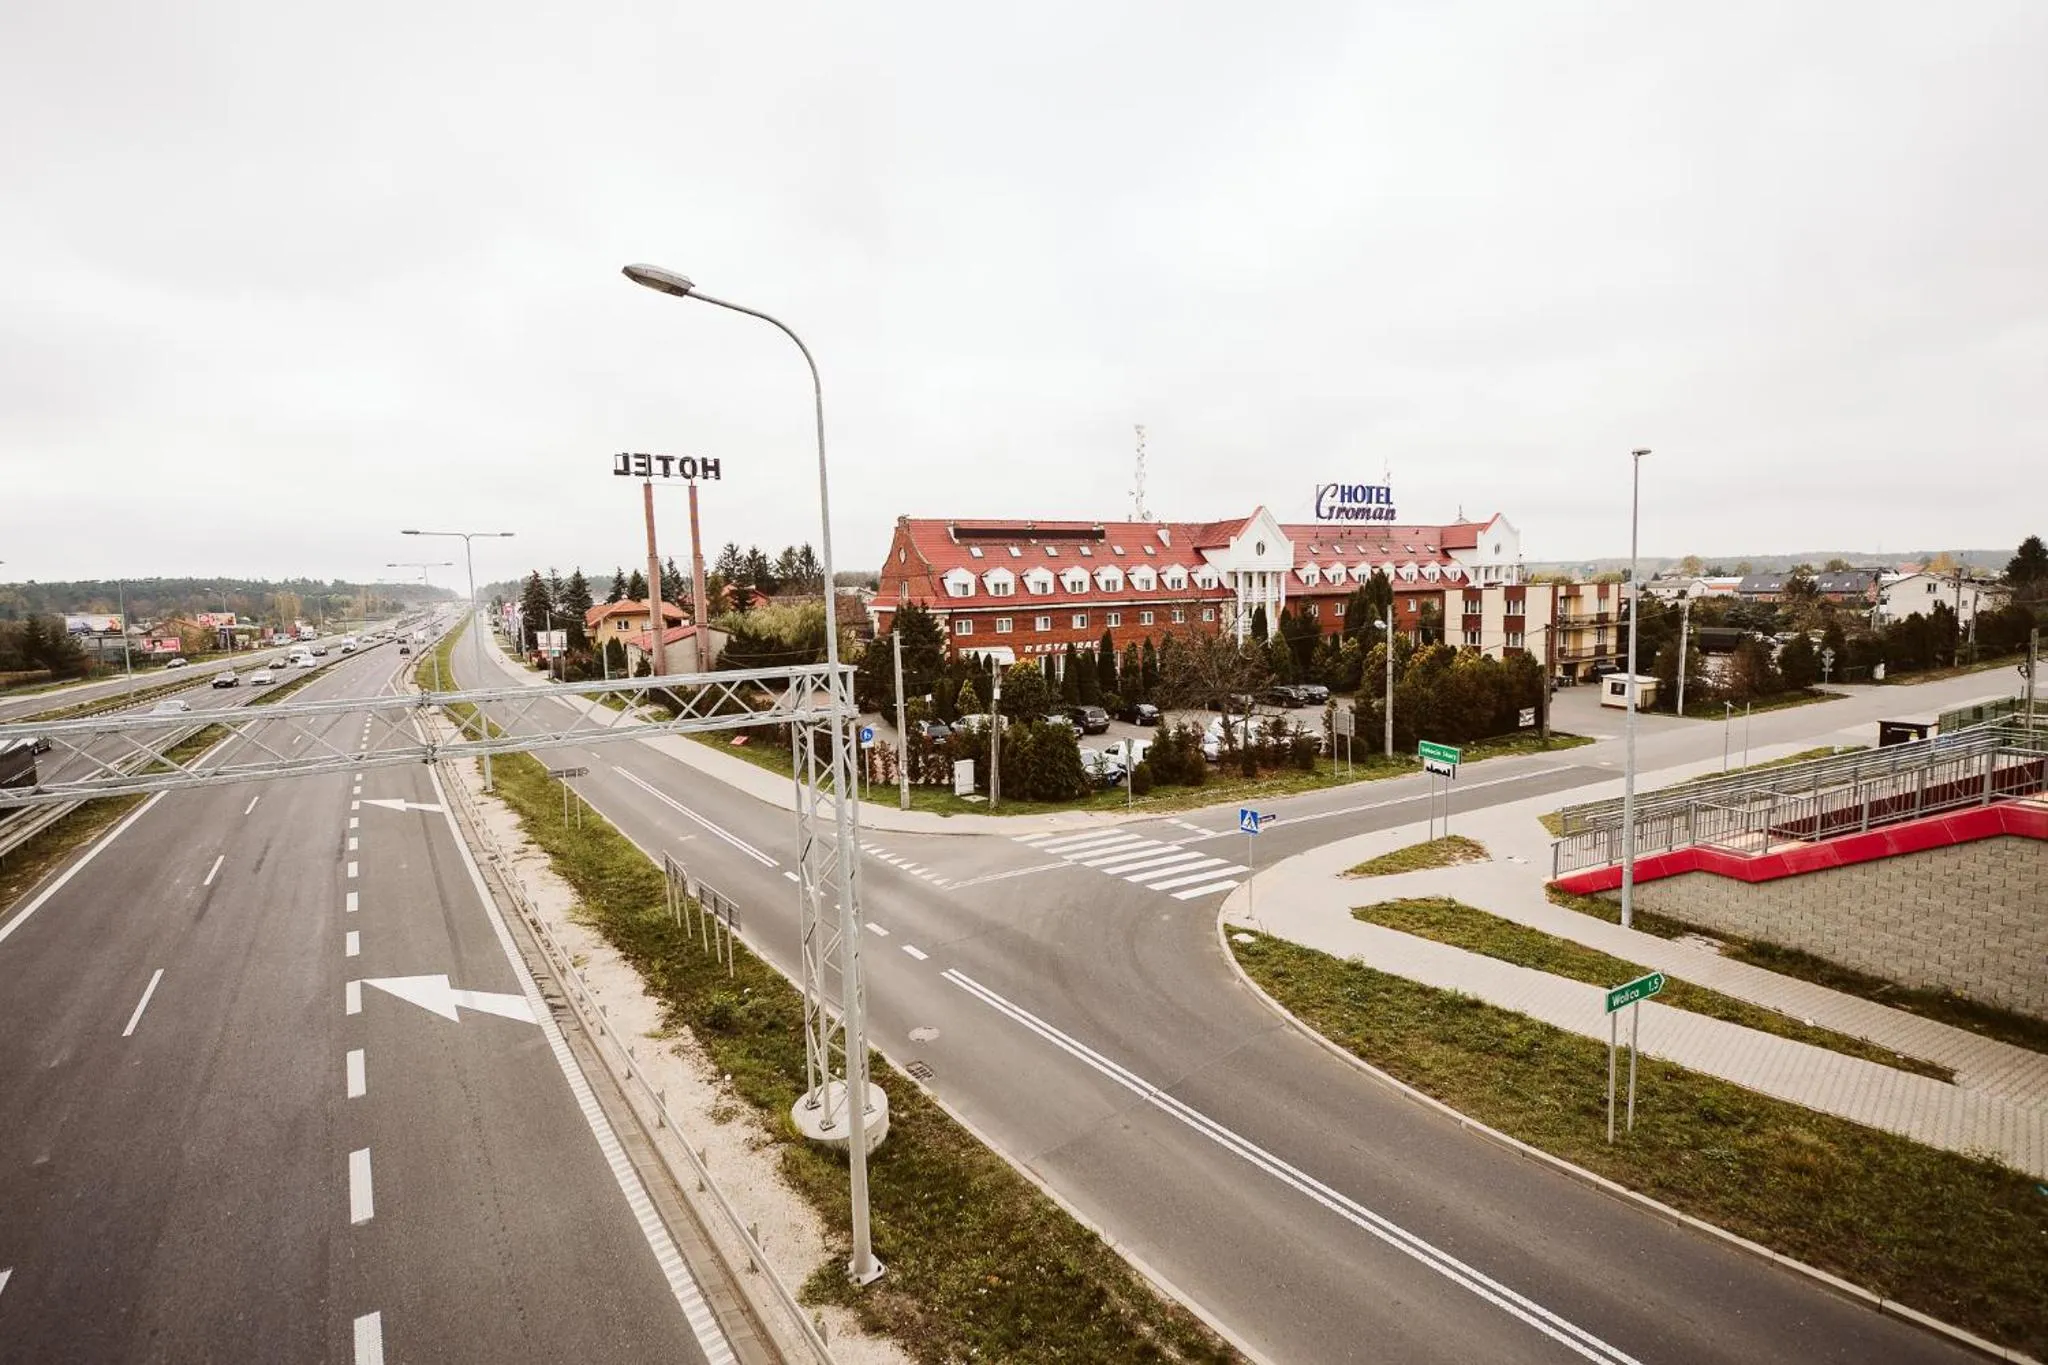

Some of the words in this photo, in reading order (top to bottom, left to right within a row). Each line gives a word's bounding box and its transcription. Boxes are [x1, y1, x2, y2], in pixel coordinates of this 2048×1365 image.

[1315, 483, 1396, 521] Groman
[1340, 485, 1393, 504] HOTEL
[1612, 989, 1639, 1006] Wolica
